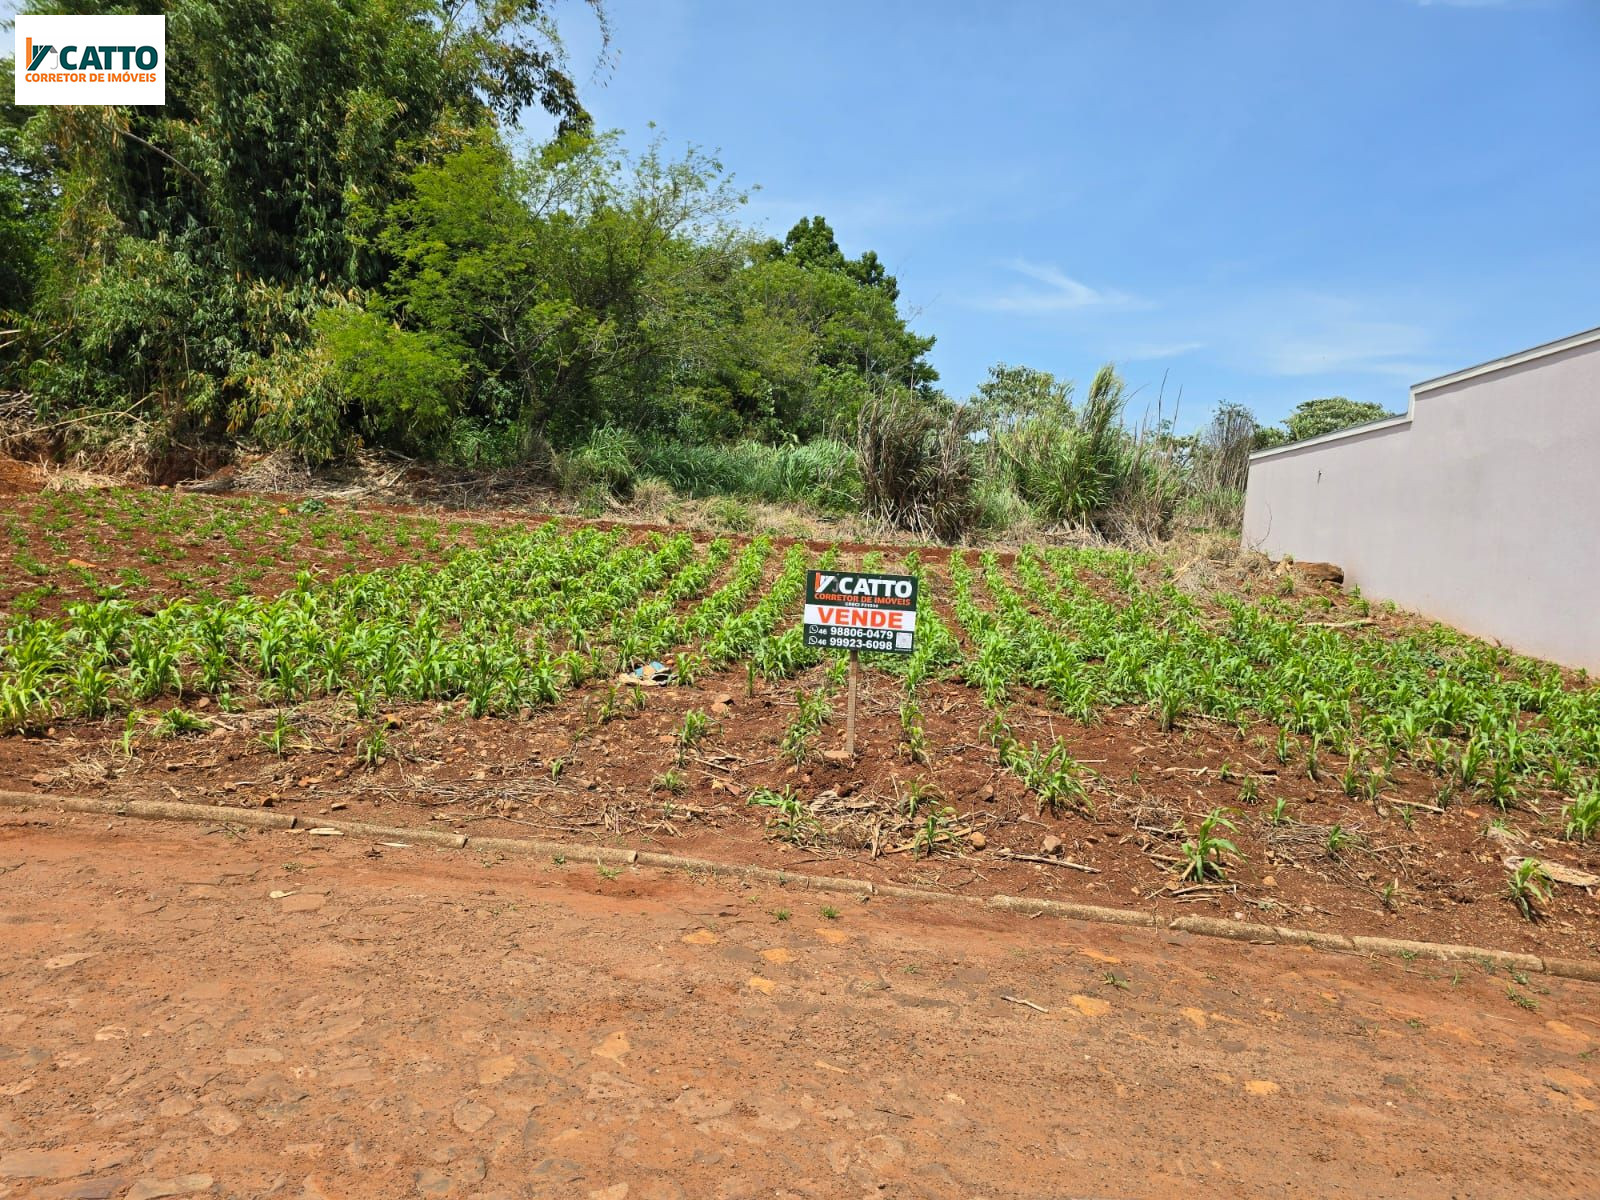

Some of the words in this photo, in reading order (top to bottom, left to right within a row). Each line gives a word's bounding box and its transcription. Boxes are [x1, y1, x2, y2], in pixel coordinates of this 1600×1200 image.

[839, 577, 912, 598] CATTO
[815, 593, 858, 602] CORRETOR
[861, 595, 873, 603] DE
[818, 607, 903, 628] VENDE
[830, 626, 894, 640] 98806-0479
[829, 638, 893, 650] 99923-6098
